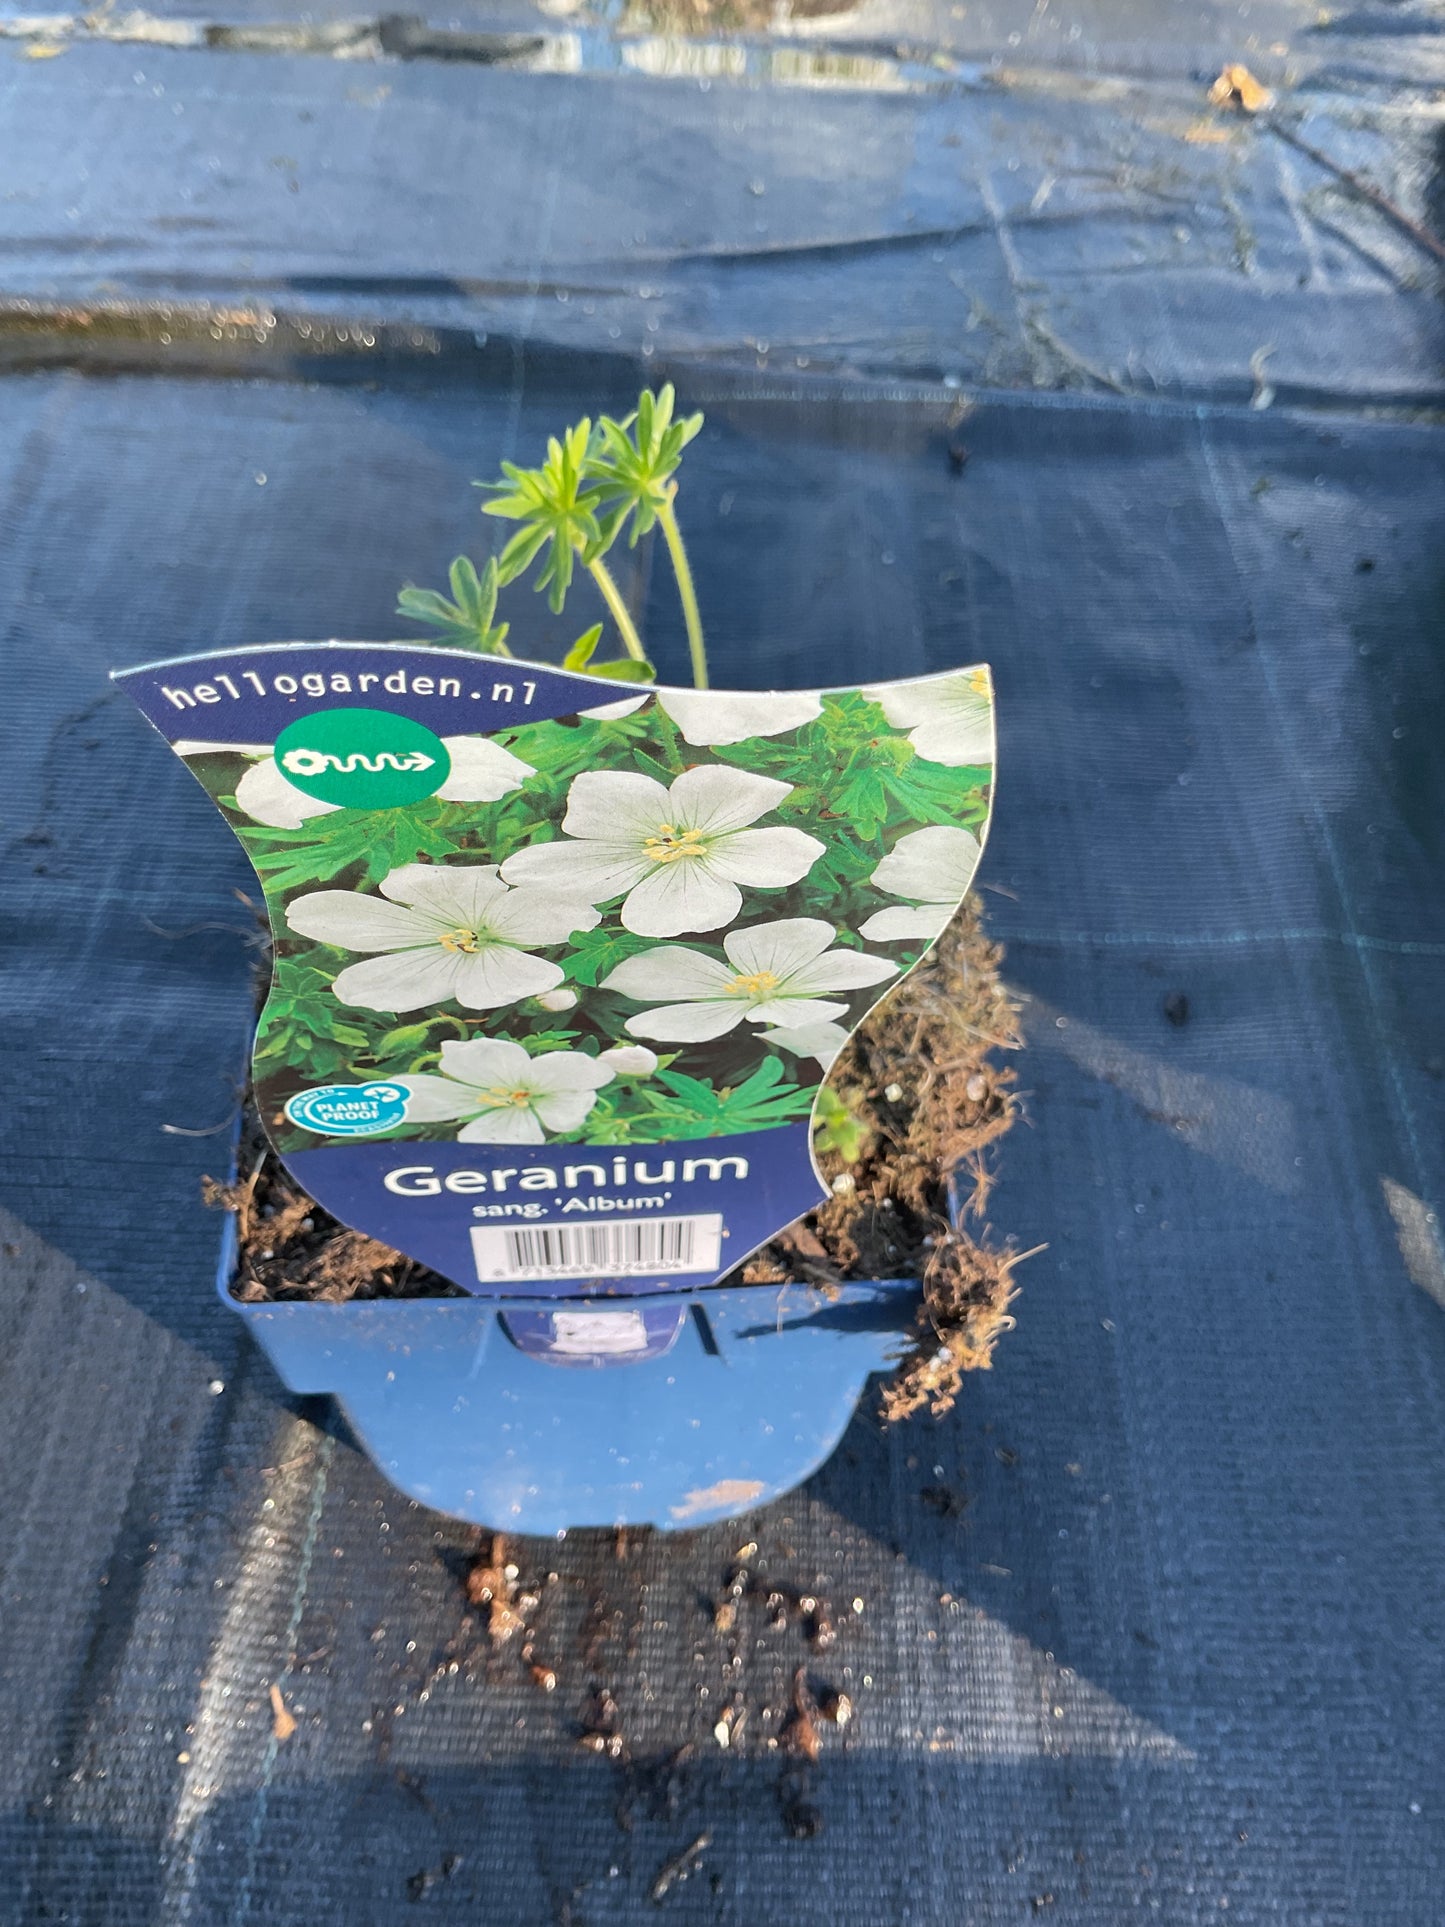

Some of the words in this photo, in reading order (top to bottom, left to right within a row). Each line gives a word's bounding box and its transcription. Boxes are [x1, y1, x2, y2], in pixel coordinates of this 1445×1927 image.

[161, 670, 537, 710] hellogarden.nl
[315, 1101, 379, 1113] PLANET
[321, 1110, 380, 1122] PROOF
[383, 1155, 750, 1197] Geranium
[472, 1202, 549, 1219] sang.
[554, 1191, 673, 1214] 'Album'
